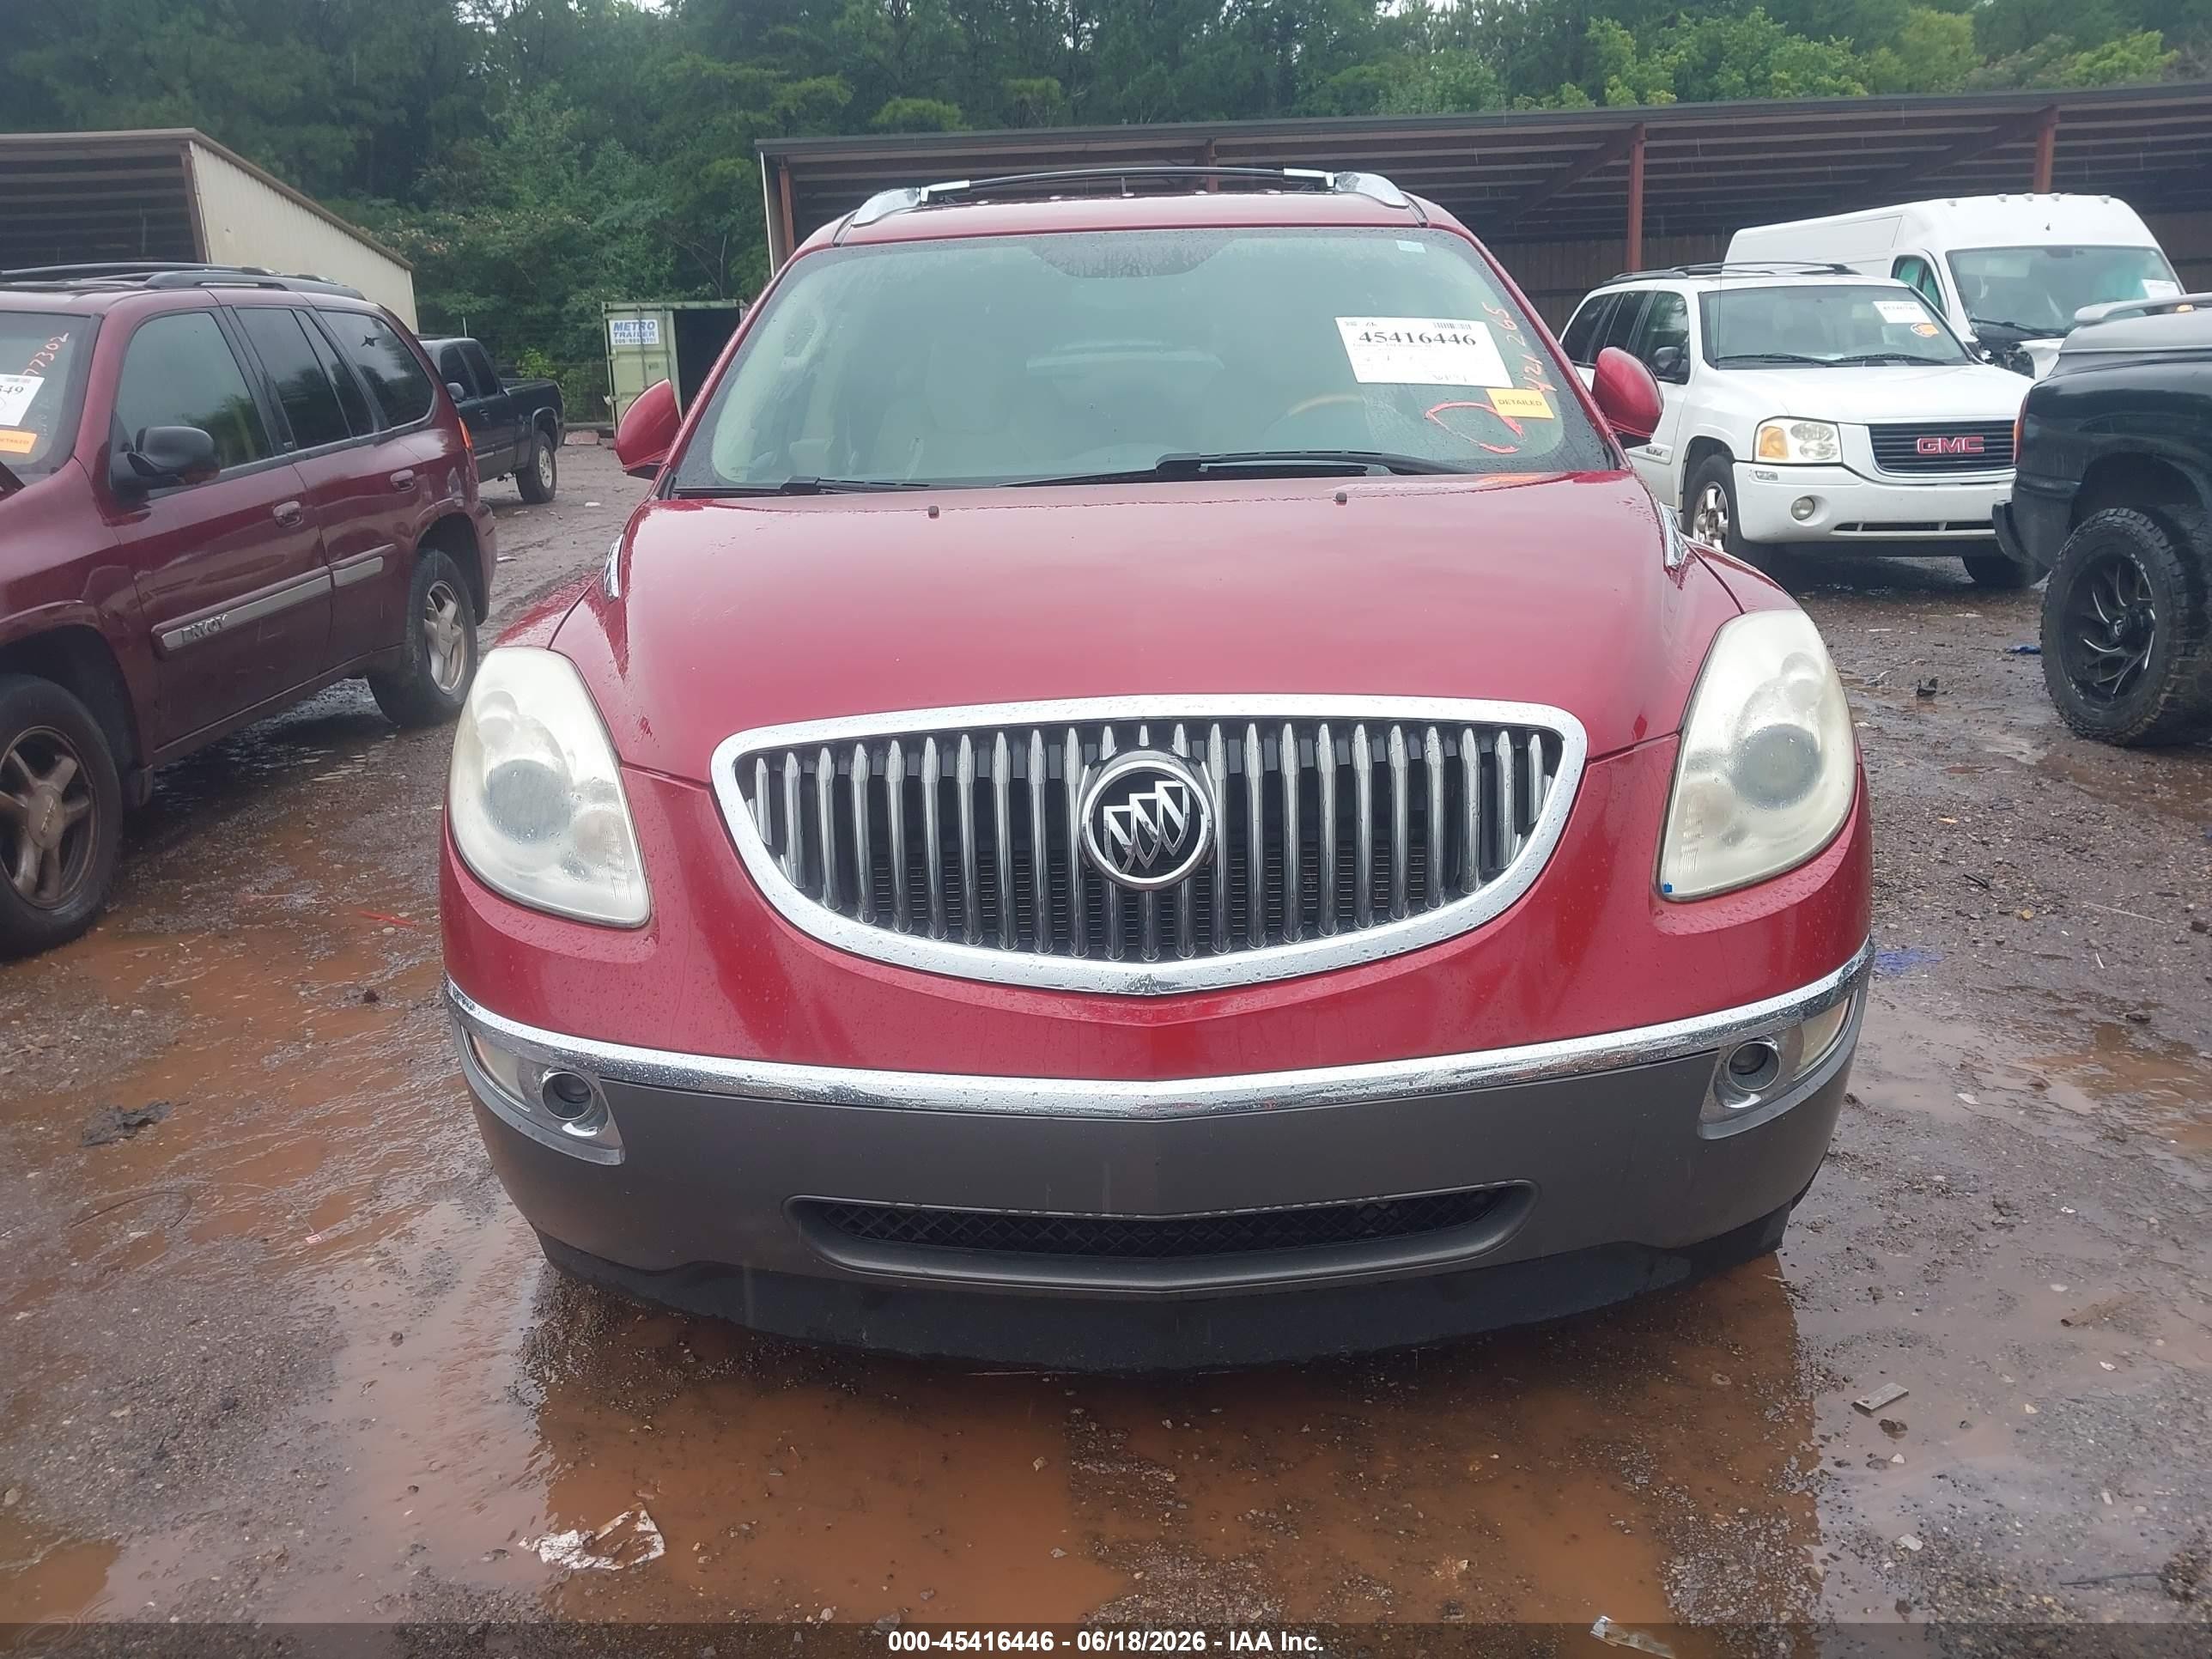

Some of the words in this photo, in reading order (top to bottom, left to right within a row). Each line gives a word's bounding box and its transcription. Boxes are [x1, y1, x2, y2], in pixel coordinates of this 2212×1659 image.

[614, 321, 655, 331] METRO
[1358, 331, 1477, 346] 45416446
[1498, 398, 1543, 407] DETAILED
[1917, 436, 1985, 454] GMC
[180, 612, 228, 643] ENVOY
